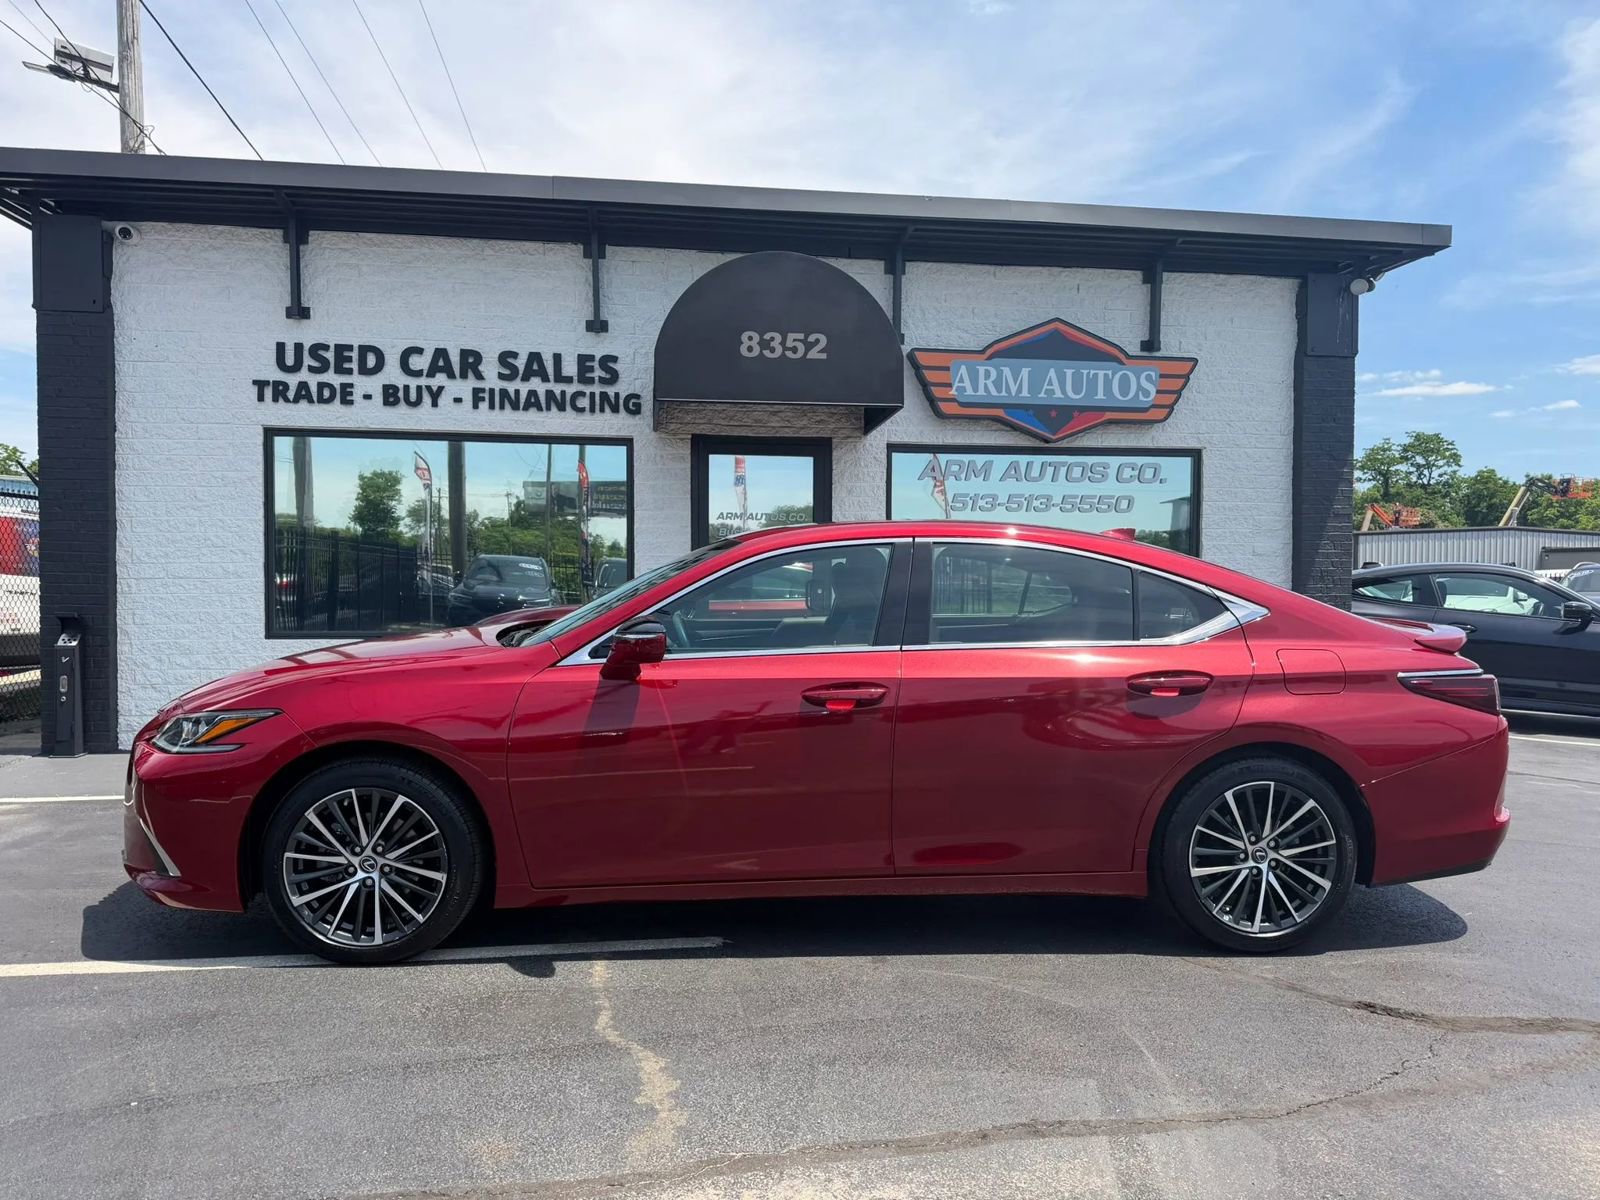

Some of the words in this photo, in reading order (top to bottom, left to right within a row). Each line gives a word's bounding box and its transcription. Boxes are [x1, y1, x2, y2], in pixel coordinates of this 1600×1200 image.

[739, 330, 828, 360] 8352
[275, 341, 386, 376] USED
[399, 345, 486, 381] CAR
[497, 350, 620, 386] SALES
[251, 379, 355, 406] TRADE
[381, 383, 446, 408] BUY
[471, 386, 643, 416] FINANCING
[949, 364, 1032, 398] ARM
[1038, 368, 1158, 402] AUTOS
[918, 459, 994, 482] ARM
[999, 460, 1109, 484] AUTOS
[1115, 462, 1168, 485] CO.
[716, 511, 743, 521] ARM
[746, 512, 786, 521] AUTOS
[788, 512, 808, 522] CO.
[949, 492, 1136, 514] 513-513-5550
